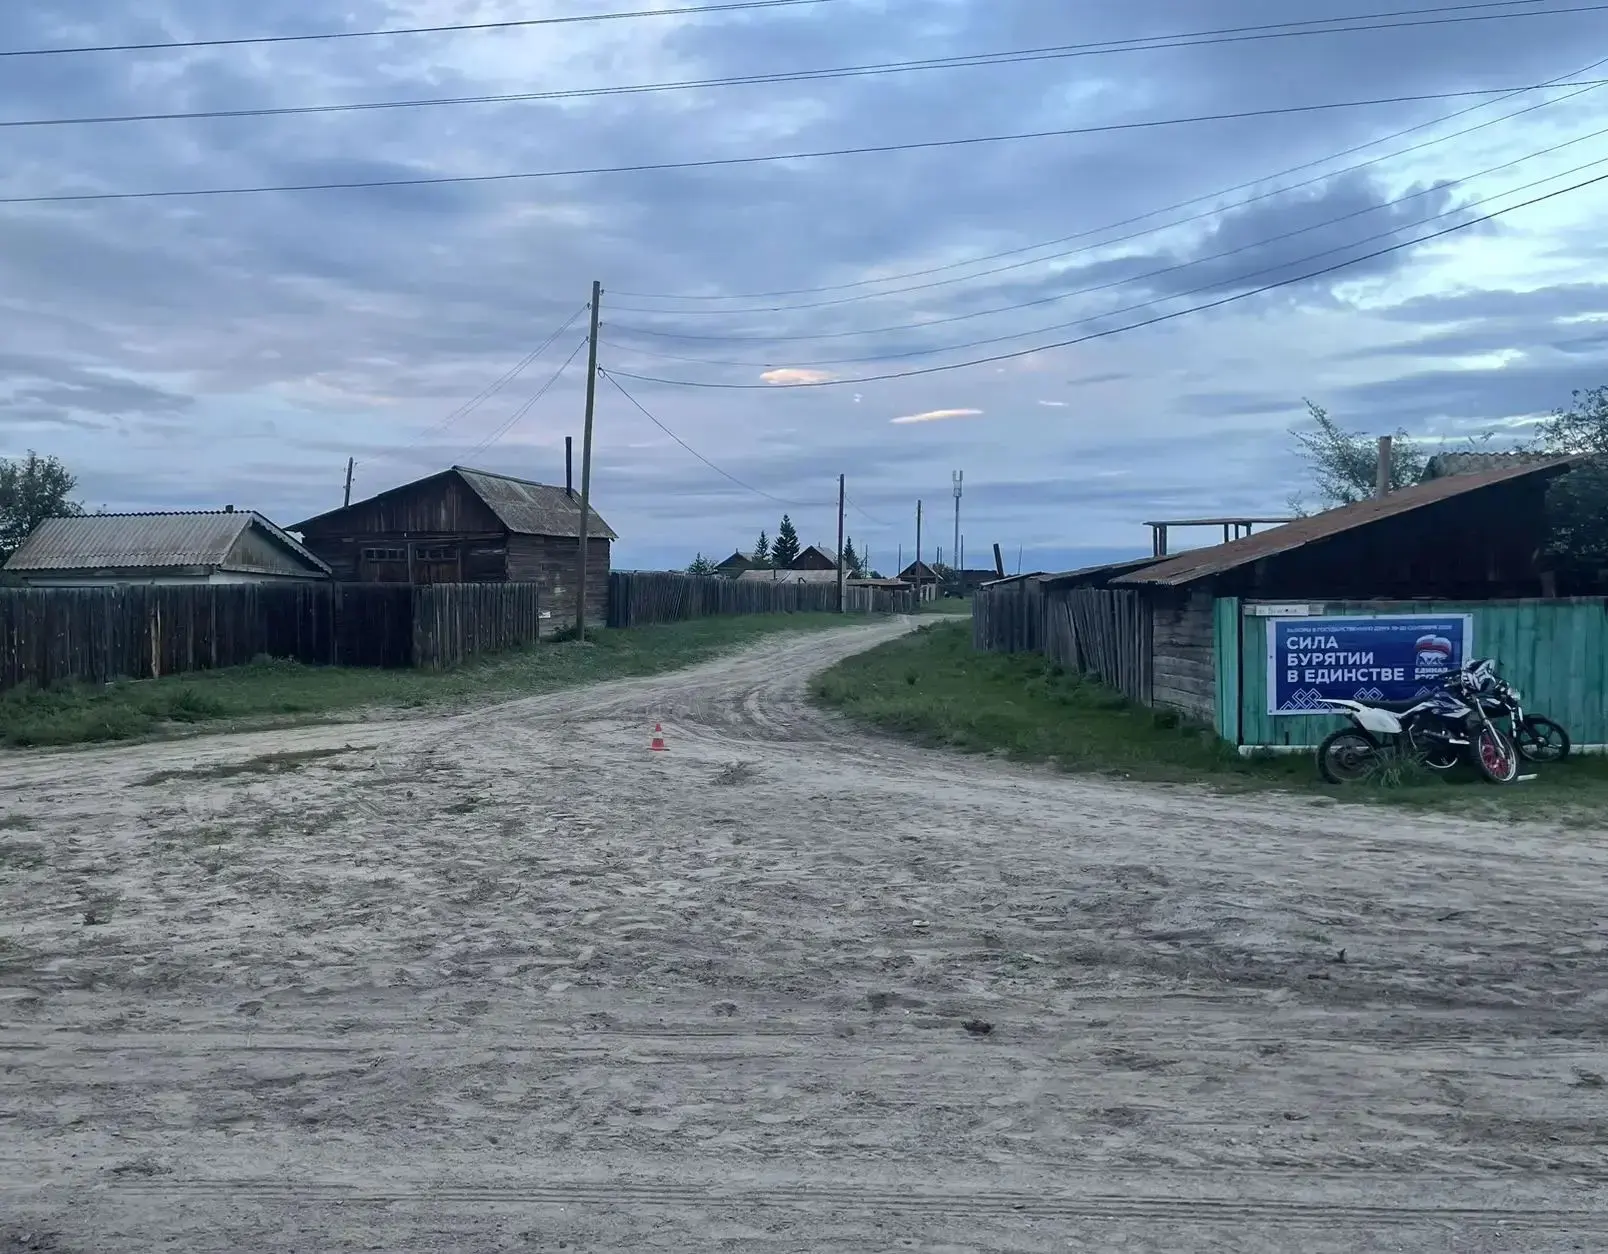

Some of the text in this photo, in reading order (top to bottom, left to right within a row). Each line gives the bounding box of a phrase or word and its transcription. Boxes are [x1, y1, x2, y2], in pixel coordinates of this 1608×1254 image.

[1286, 636, 1339, 650] СИЛА
[1287, 652, 1374, 666] БУРЯТИИ
[1287, 668, 1405, 684] В ЕДИНСТВЕ
